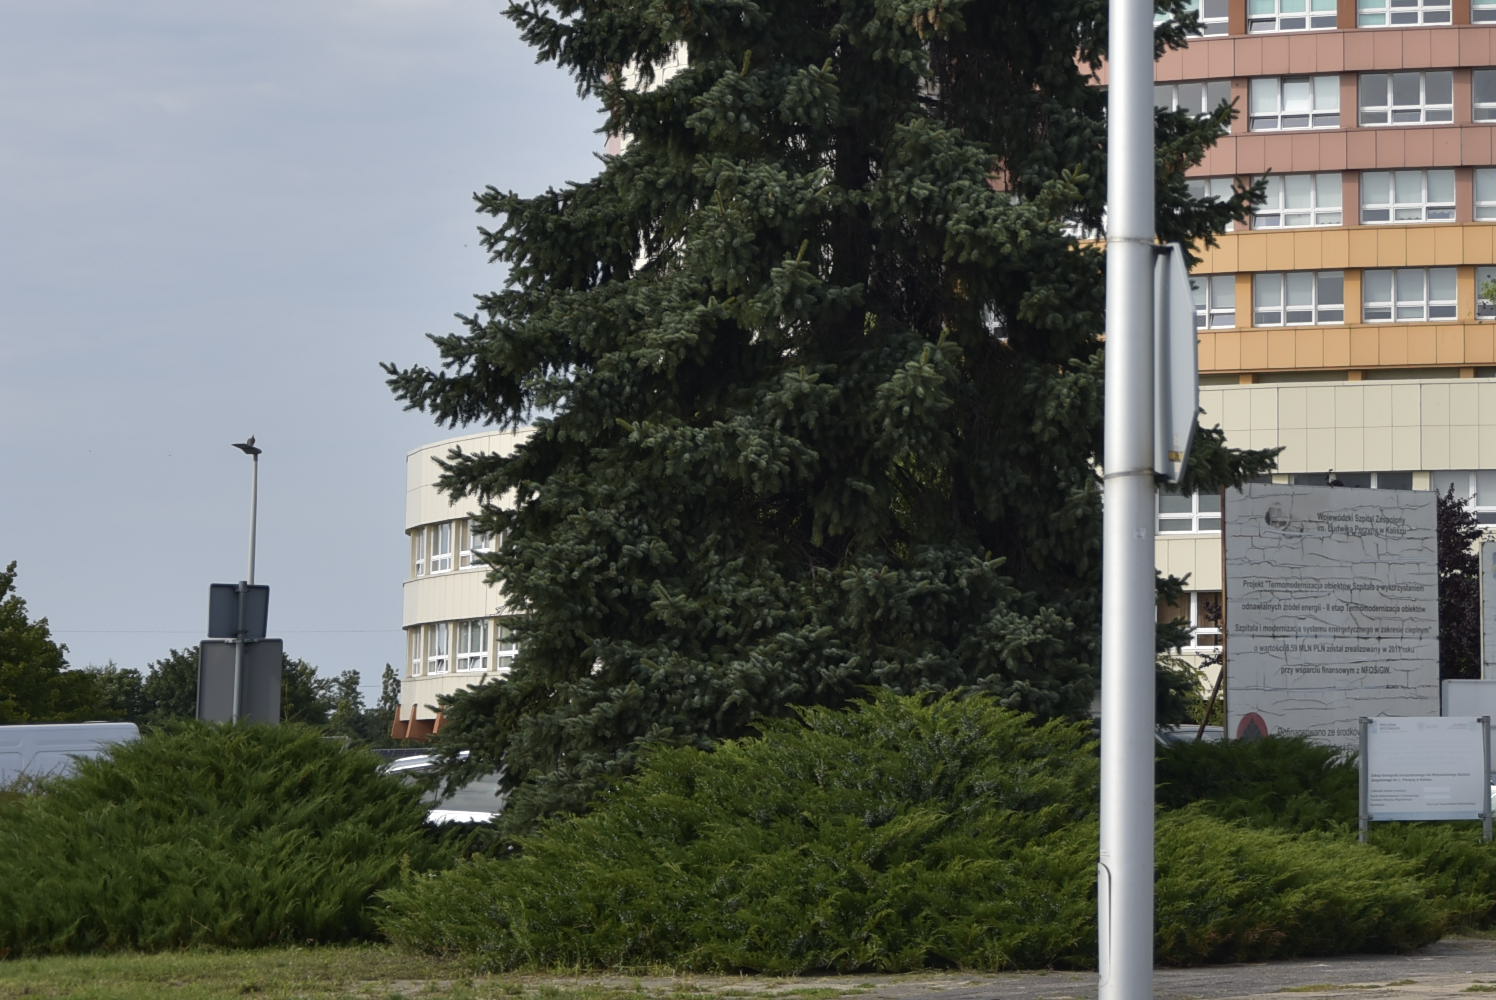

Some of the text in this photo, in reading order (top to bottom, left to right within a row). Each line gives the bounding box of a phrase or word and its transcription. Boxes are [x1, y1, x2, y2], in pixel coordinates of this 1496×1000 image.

[1354, 513, 1375, 523] Szpital
[1385, 526, 1406, 534] Kaliszu
[1242, 580, 1264, 590] Projekt
[1241, 602, 1281, 612] odnawialnych
[1331, 605, 1344, 613] etap
[1313, 644, 1325, 652] PLN
[1280, 667, 1294, 675] przy
[1295, 666, 1321, 675] wsparciu
[1322, 666, 1355, 675] finansowym
